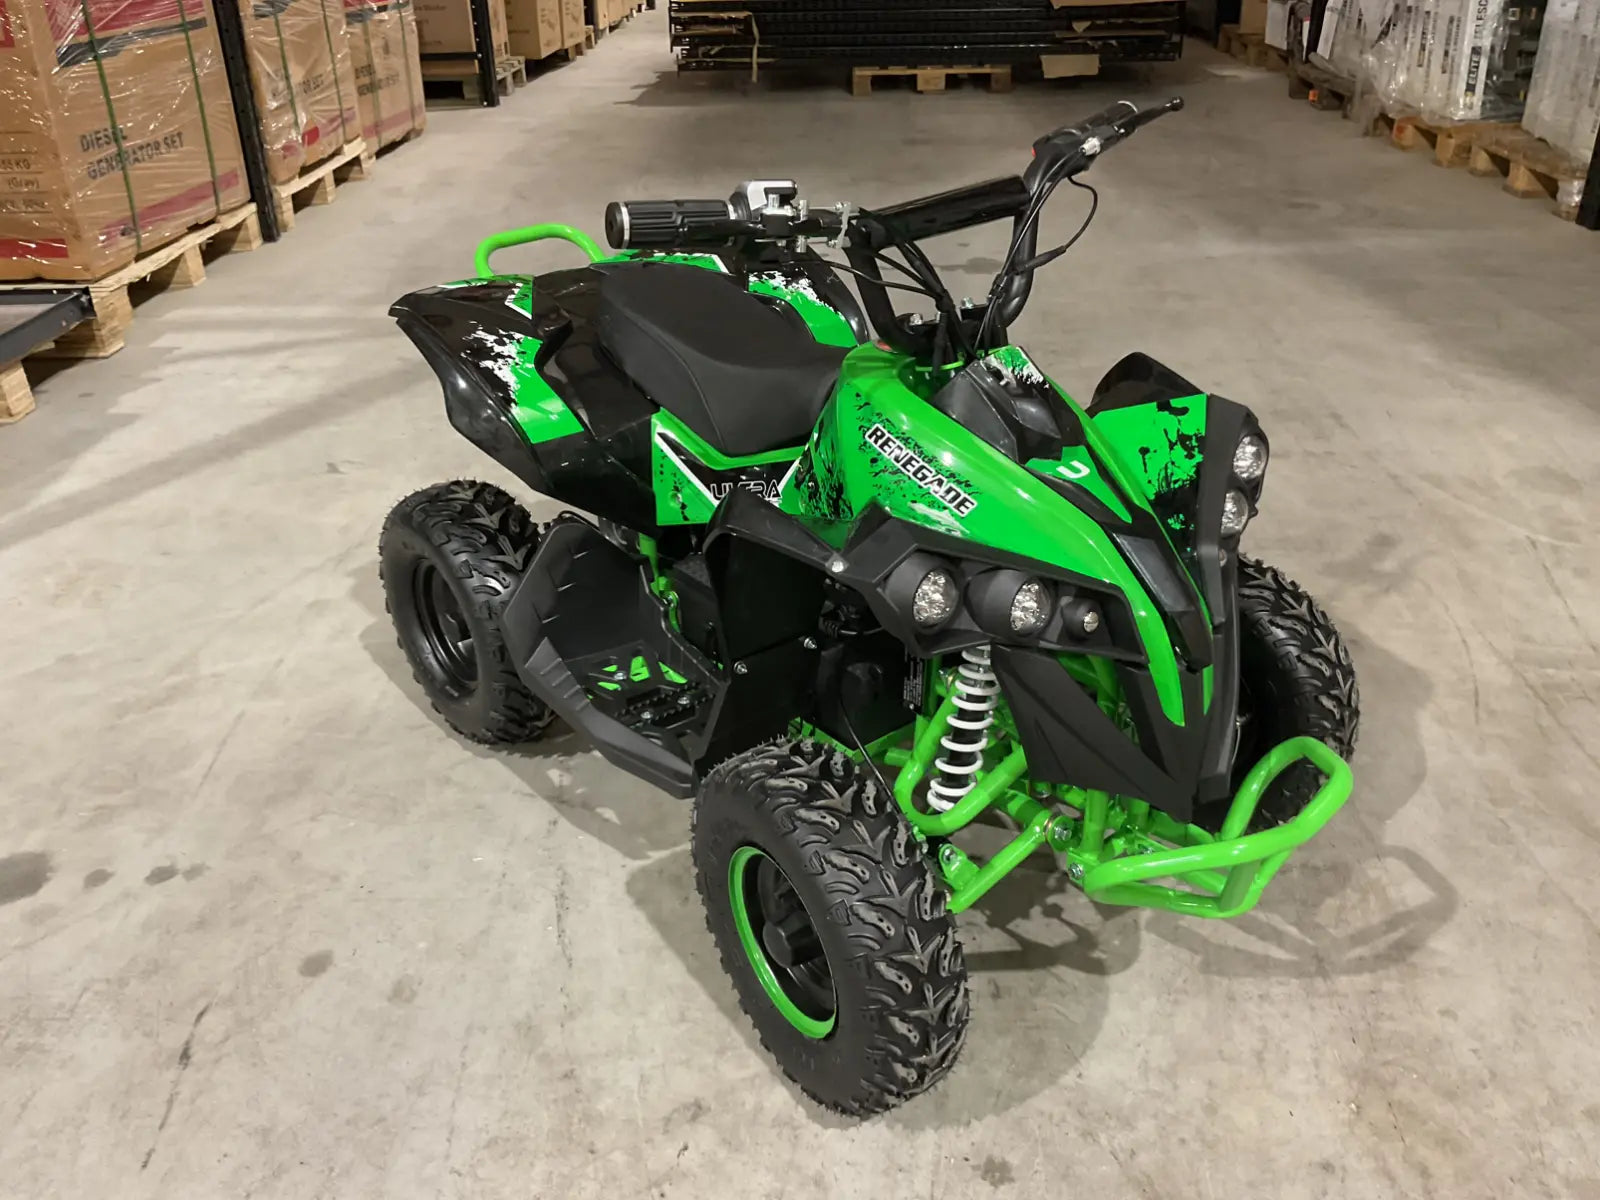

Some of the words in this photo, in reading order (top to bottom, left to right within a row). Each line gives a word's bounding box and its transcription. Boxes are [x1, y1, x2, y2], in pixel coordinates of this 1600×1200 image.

[163, 131, 184, 153] SET
[866, 424, 977, 516] RENEGADE
[710, 480, 782, 500] UTRA
